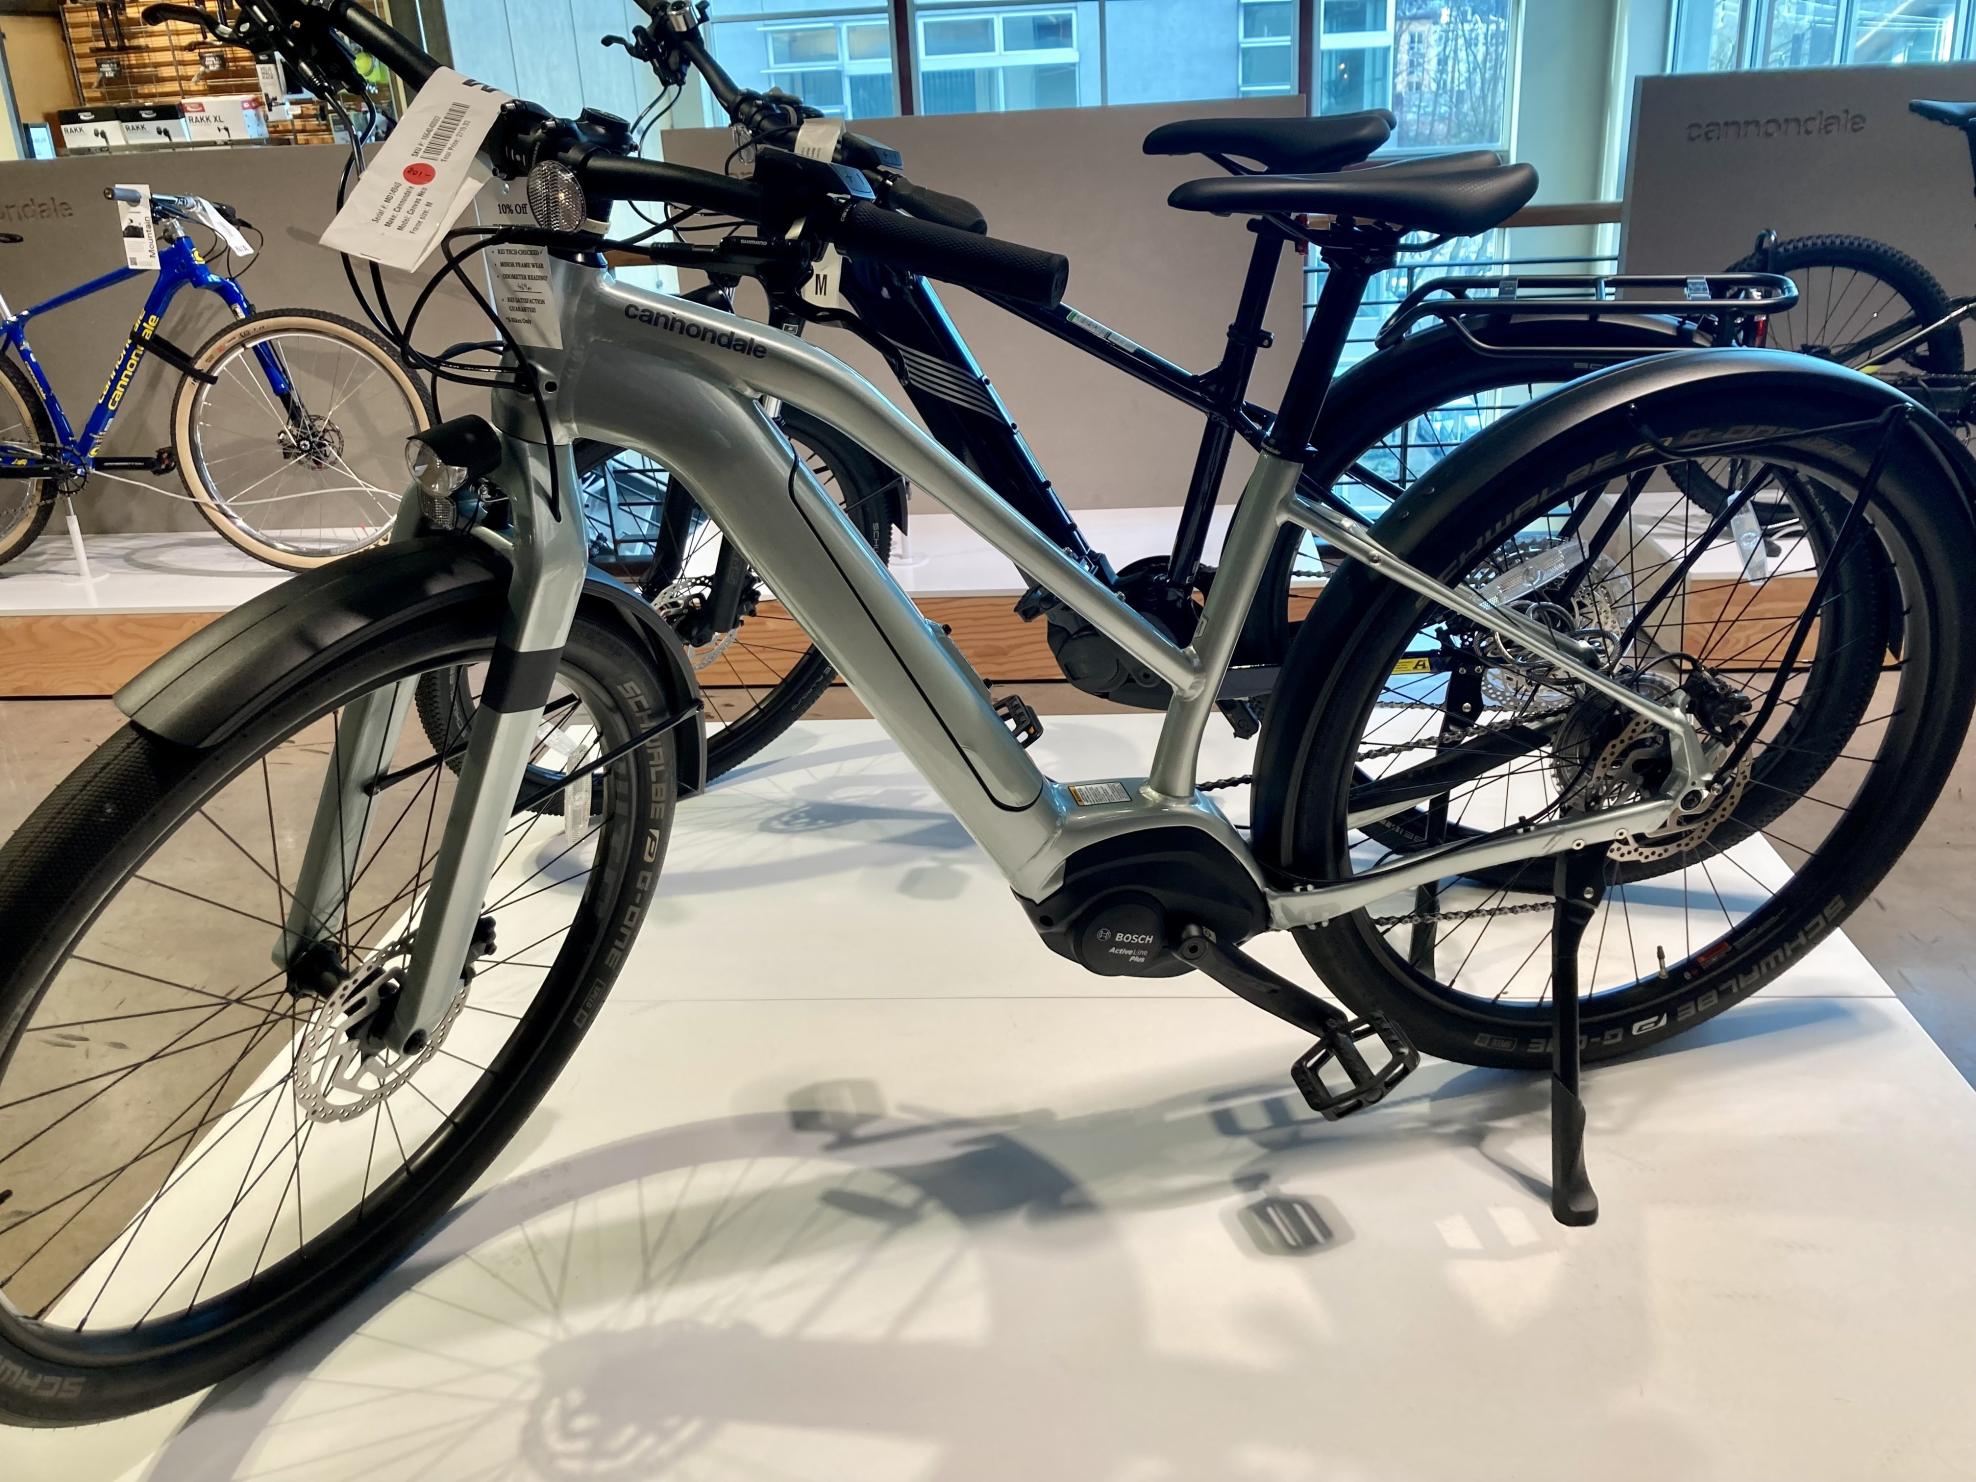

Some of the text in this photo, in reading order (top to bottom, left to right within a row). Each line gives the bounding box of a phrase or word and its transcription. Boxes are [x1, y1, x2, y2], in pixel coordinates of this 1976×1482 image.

[63, 126, 85, 135] RAKK
[125, 124, 146, 132] RAKK
[188, 114, 224, 124] RAKK XL
[1686, 109, 1866, 142] cannondale
[498, 203, 528, 215] 10% Off
[143, 217, 156, 259] Mountain
[815, 274, 828, 296] M
[625, 303, 768, 359] cannondale
[108, 314, 160, 410] cannonale
[604, 871, 653, 971] G-ONE
[1115, 932, 1153, 944] BOSCH
[1676, 894, 1847, 1022] SCHWALBE
